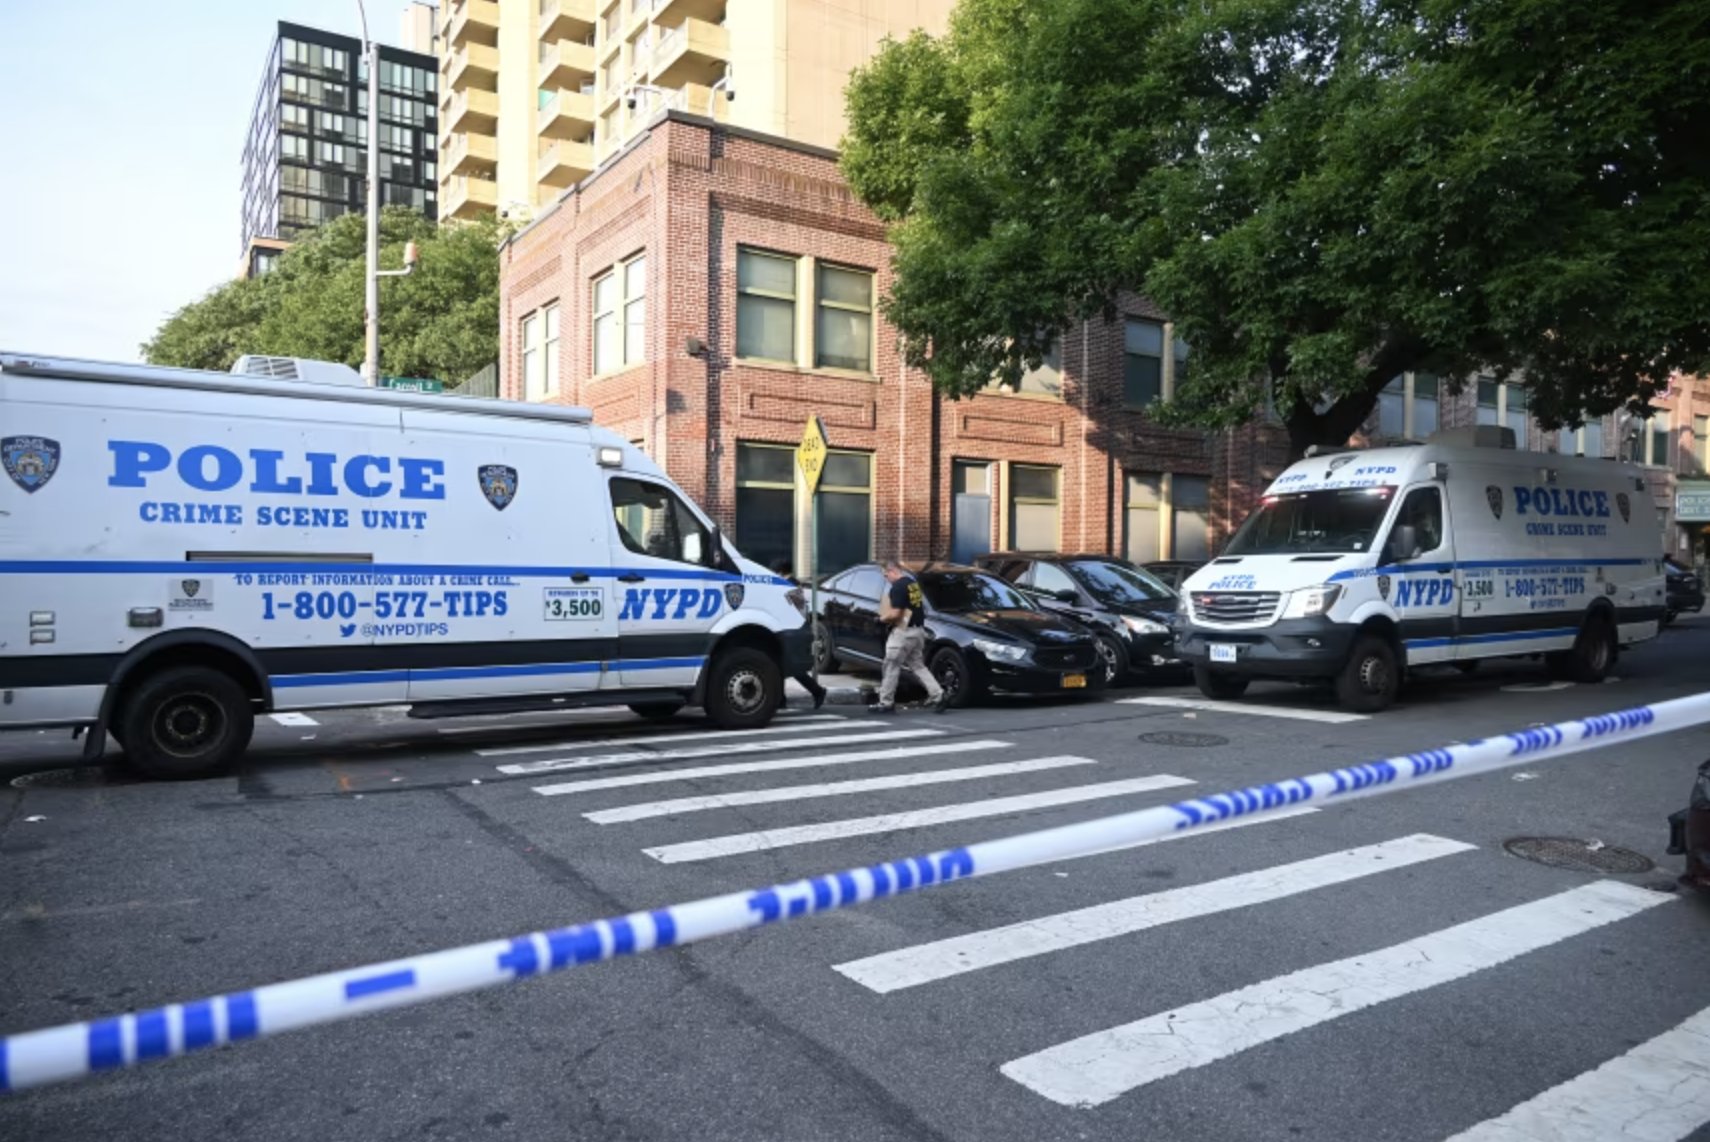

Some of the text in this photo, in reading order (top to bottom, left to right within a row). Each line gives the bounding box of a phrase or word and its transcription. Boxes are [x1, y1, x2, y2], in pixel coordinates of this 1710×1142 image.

[803, 436, 819, 452] DEAD
[107, 440, 445, 500] POLICE
[1355, 466, 1396, 475] NYPD
[1513, 486, 1610, 518] POLICE
[139, 501, 427, 530] CRIME SCENE UNIT
[1526, 522, 1554, 536] CRIME
[1558, 523, 1584, 536] SCENE
[233, 574, 253, 586] TO
[257, 574, 311, 586] REPORT
[312, 575, 394, 586] INFORMATION
[398, 575, 434, 586] ABOUT
[440, 577, 447, 586] A
[450, 576, 483, 586] CRIME
[743, 573, 772, 585] POLICE
[1208, 580, 1257, 590] POLICE
[1394, 579, 1453, 607] NYPD
[262, 590, 508, 620] 1-800-577-TIPS
[618, 588, 723, 620] NYPD
[361, 622, 449, 637] @NYPDTIPS
